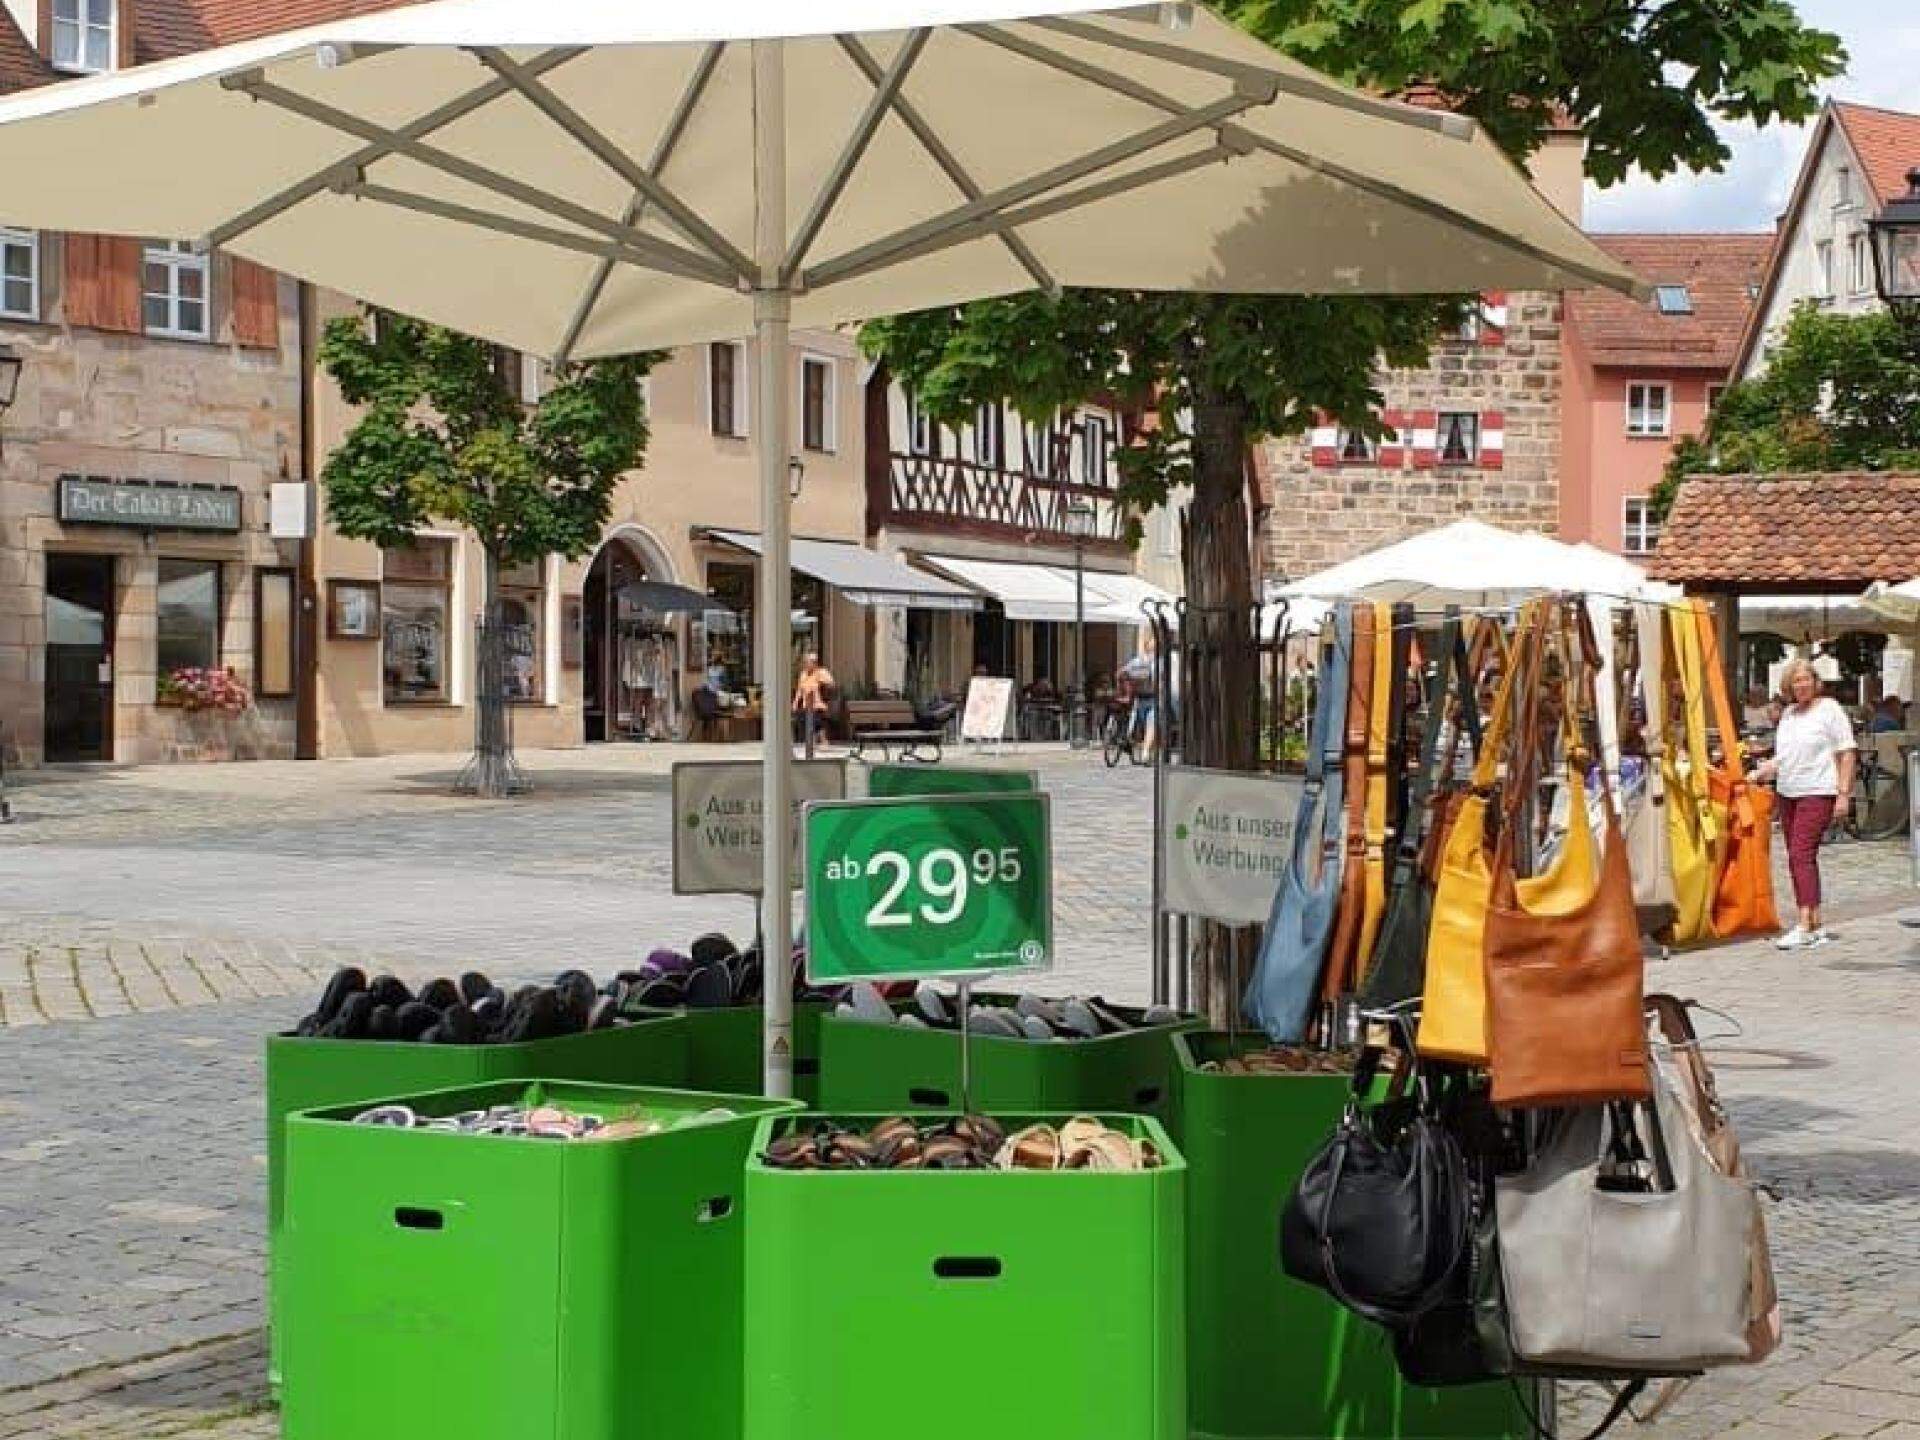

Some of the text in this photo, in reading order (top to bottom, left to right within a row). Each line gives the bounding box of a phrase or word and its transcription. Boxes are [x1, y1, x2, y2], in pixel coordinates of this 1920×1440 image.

[69, 487, 105, 512] Der
[706, 794, 746, 815] Aus
[1194, 806, 1293, 840] Aus unser
[826, 848, 1022, 927] ab 29 95
